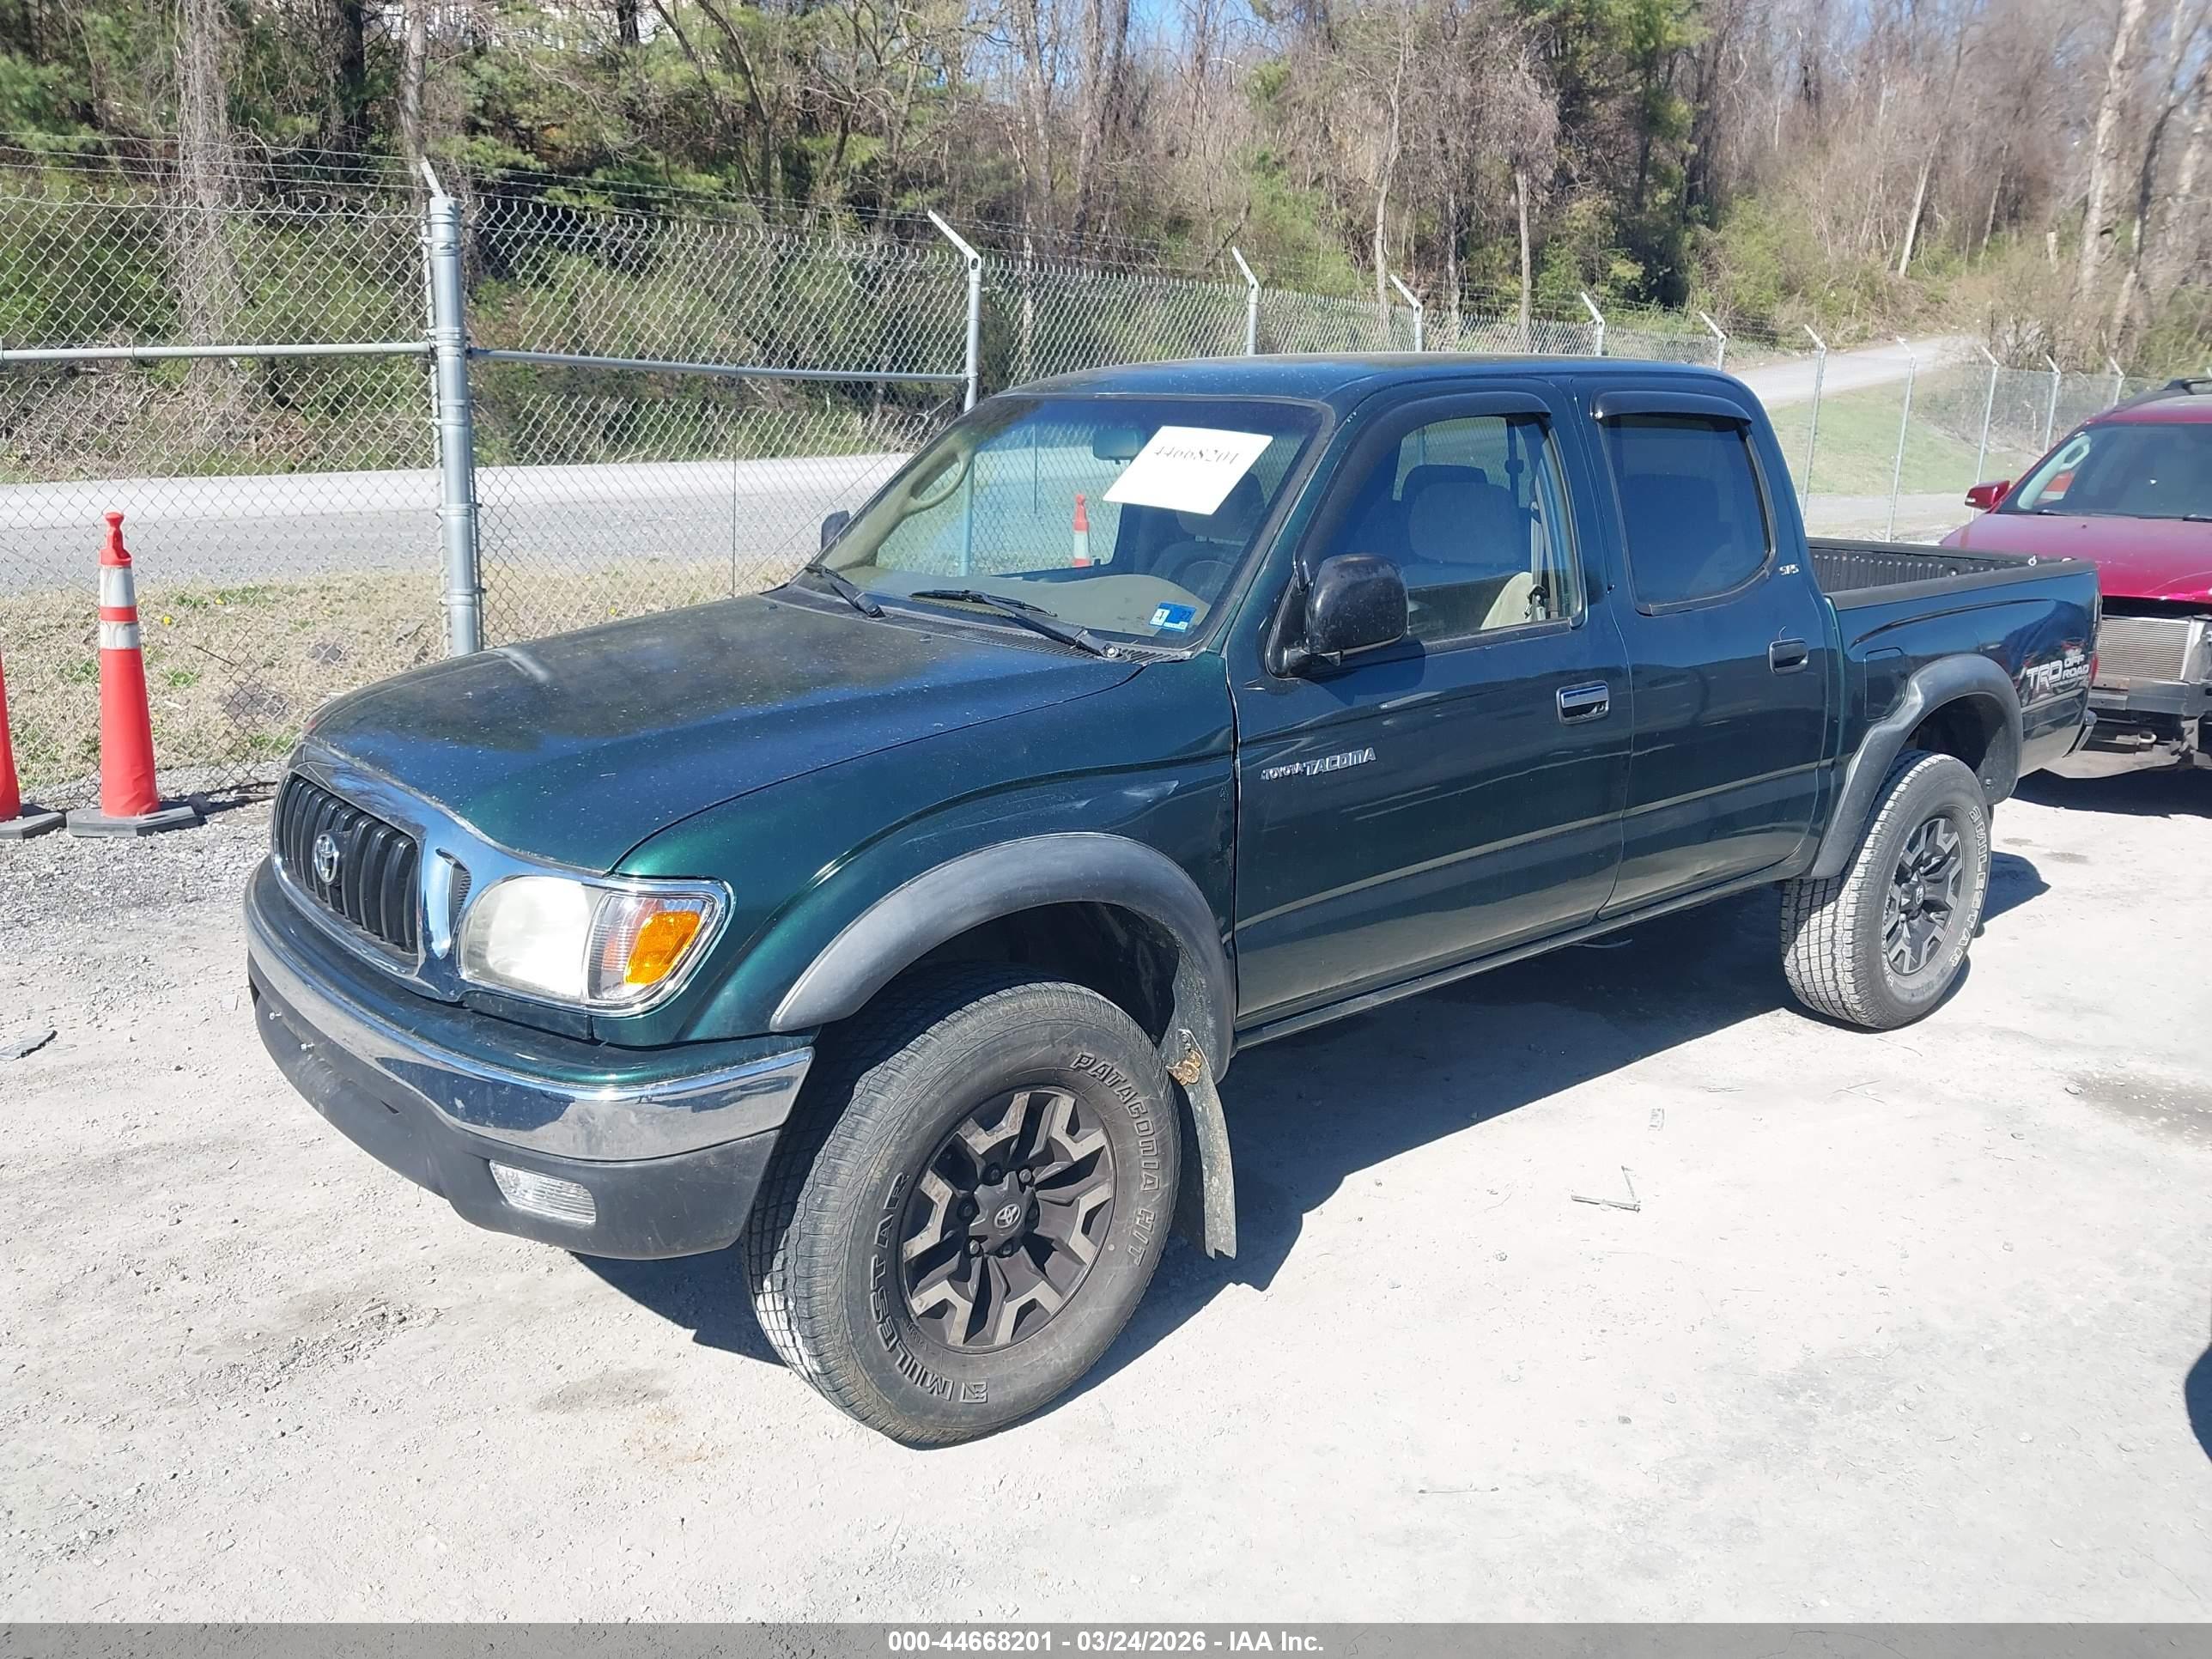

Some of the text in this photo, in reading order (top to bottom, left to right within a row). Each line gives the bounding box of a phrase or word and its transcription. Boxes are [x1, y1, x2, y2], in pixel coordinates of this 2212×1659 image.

[2026, 659, 2063, 693] TRD
[2062, 664, 2089, 680] ROAD
[2063, 653, 2085, 668] OFF
[1261, 747, 1376, 781] TOYOTA TACOMA
[1070, 1051, 1160, 1192] PATAGONIA
[870, 1171, 955, 1402] MILLESTAR
